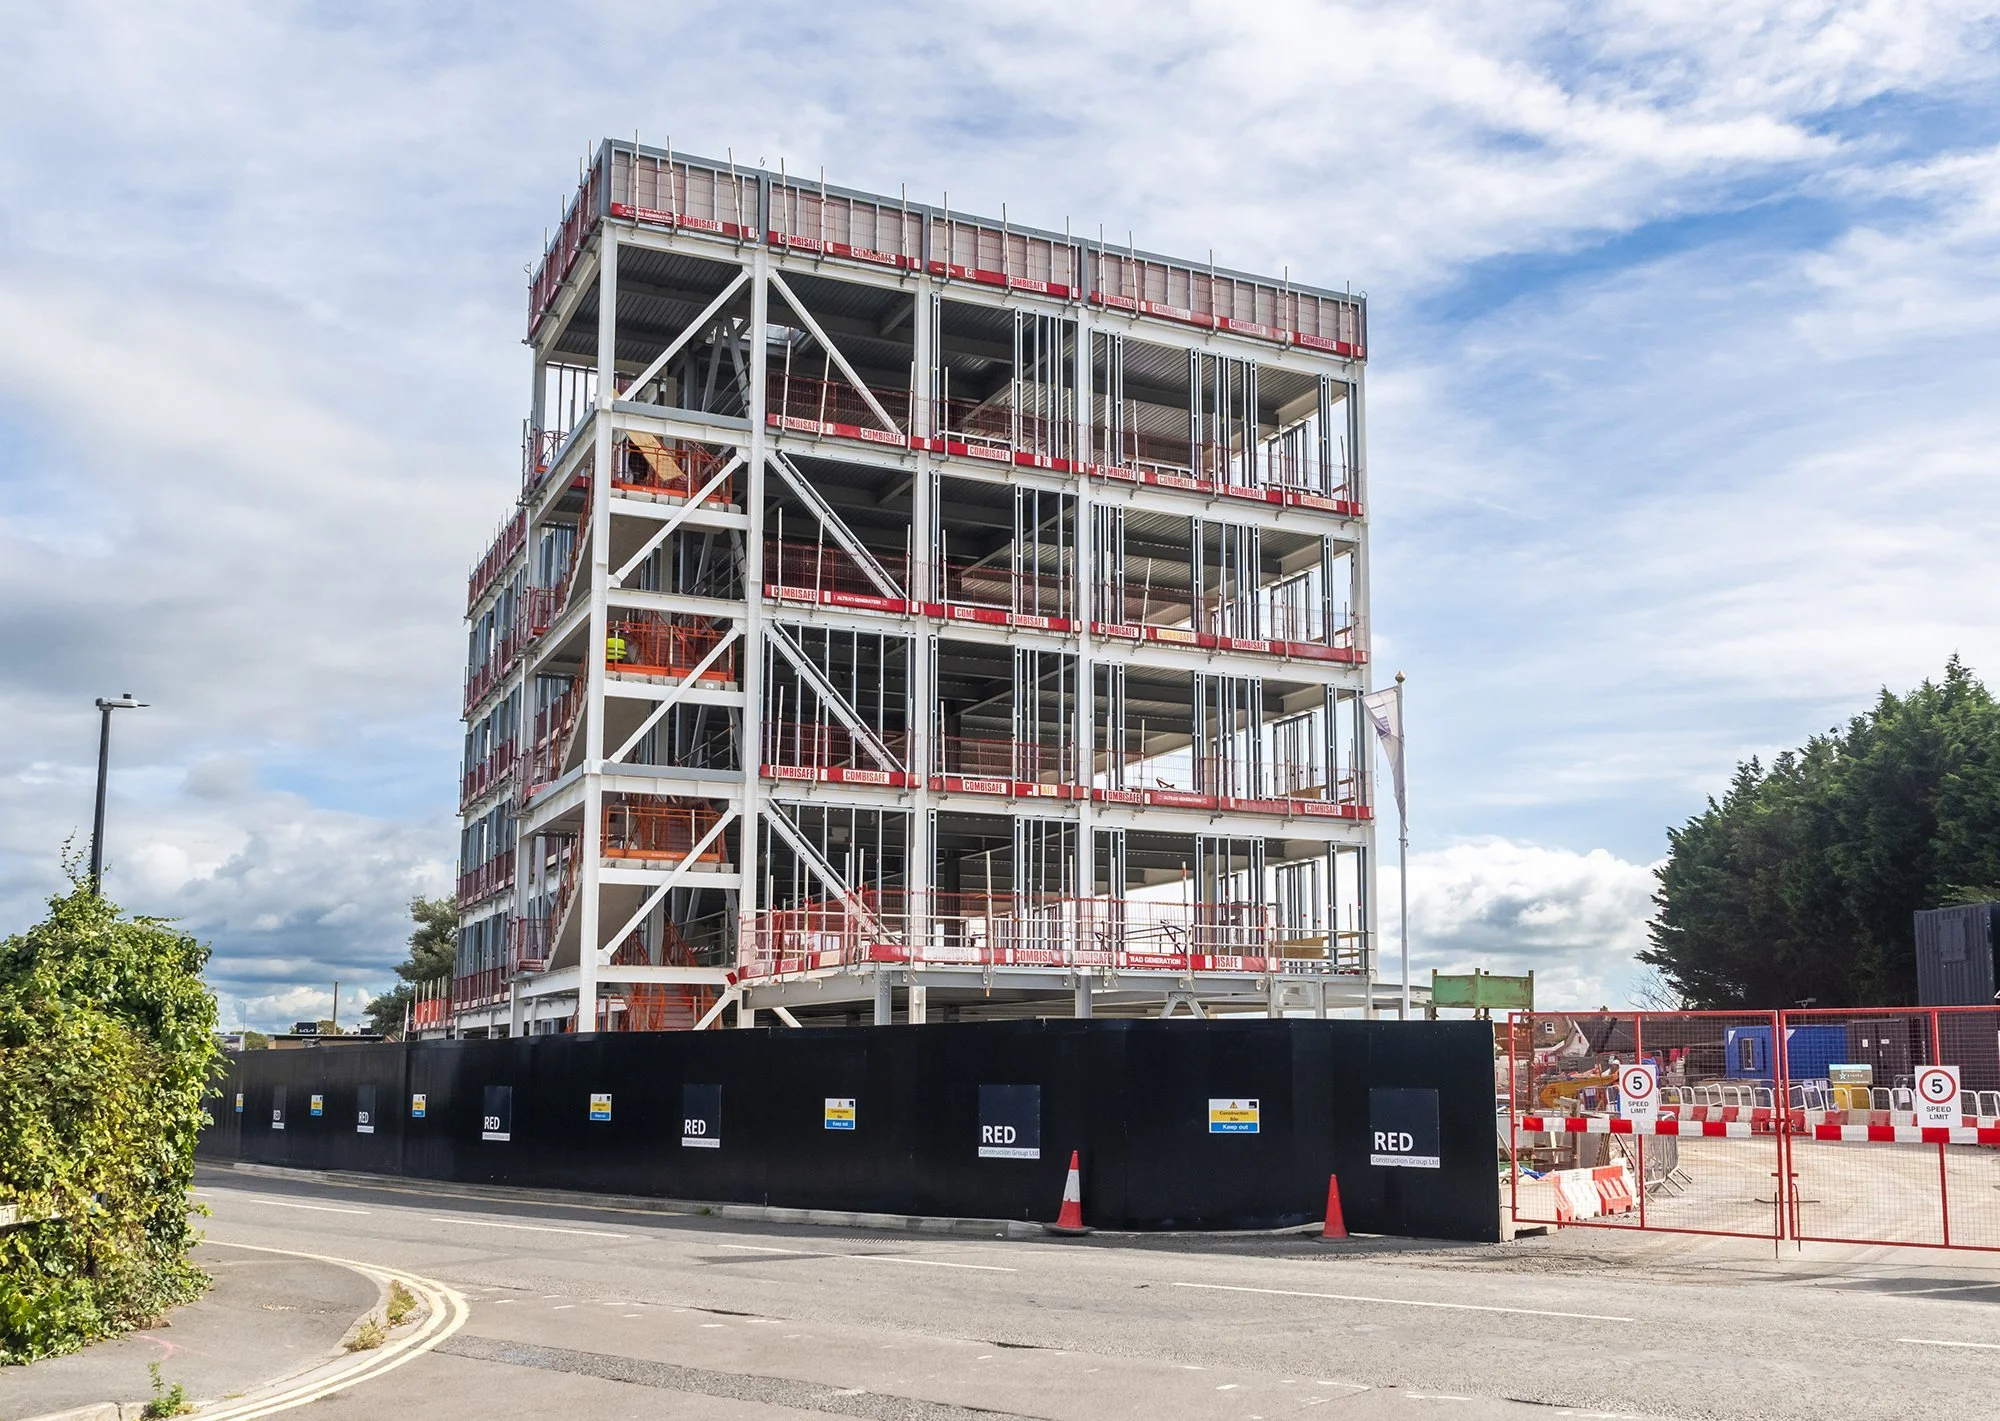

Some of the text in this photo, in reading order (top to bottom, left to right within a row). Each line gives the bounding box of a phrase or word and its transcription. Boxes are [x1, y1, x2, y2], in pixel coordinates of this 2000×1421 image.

[1230, 319, 1264, 335] COMBISAFE
[1301, 333, 1334, 350] COMBISAFE
[862, 429, 902, 444] COMBISAFE
[969, 446, 1007, 460] COMBISAFE
[1099, 466, 1134, 480] CMBISAFE
[1159, 475, 1194, 488] COMBISAFE
[1230, 486, 1264, 499] COMBISAFE
[1158, 629, 1194, 642] COMBISAFE
[1233, 638, 1267, 651] COMBISAFE
[845, 771, 886, 783] COMBISAFE
[964, 781, 1003, 793] COMBISAFE
[1306, 804, 1340, 815] COMBISAFE
[1144, 956, 1181, 965] GENERATION
[1633, 1076, 1643, 1090] 5
[1931, 1078, 1944, 1094] 5
[358, 1111, 370, 1124] RED
[484, 1116, 500, 1130] RED
[684, 1119, 706, 1135] RED
[982, 1125, 1017, 1144] RED
[1374, 1131, 1414, 1152] RED
[979, 1148, 1011, 1156] Construction
[1012, 1149, 1028, 1157] Group
[1371, 1156, 1409, 1164] Construction
[1409, 1157, 1428, 1166] Group
